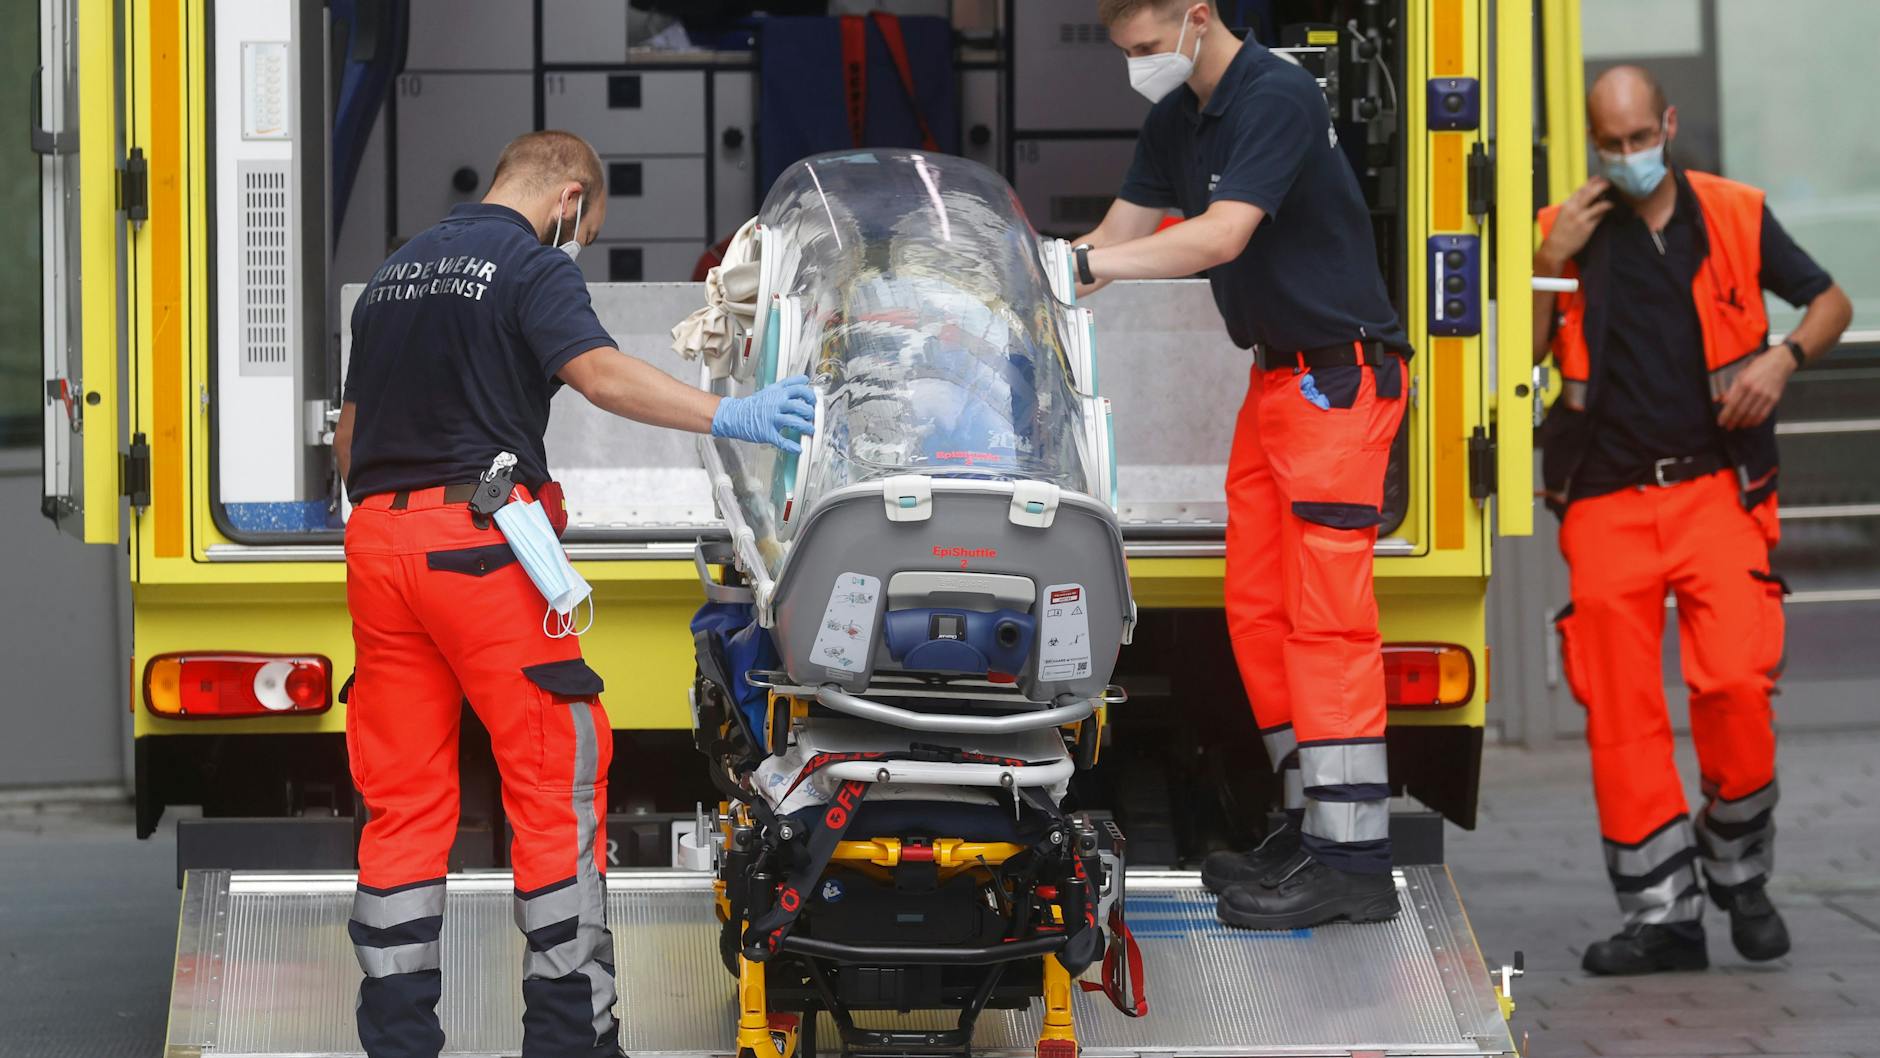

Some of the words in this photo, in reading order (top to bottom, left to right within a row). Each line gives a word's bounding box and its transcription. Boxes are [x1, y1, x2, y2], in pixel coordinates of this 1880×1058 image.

[401, 75, 422, 97] 10
[547, 76, 565, 96] 11
[373, 256, 497, 282] UNDEWEHR
[932, 545, 998, 558] EpiShuttle
[960, 560, 968, 568] 2
